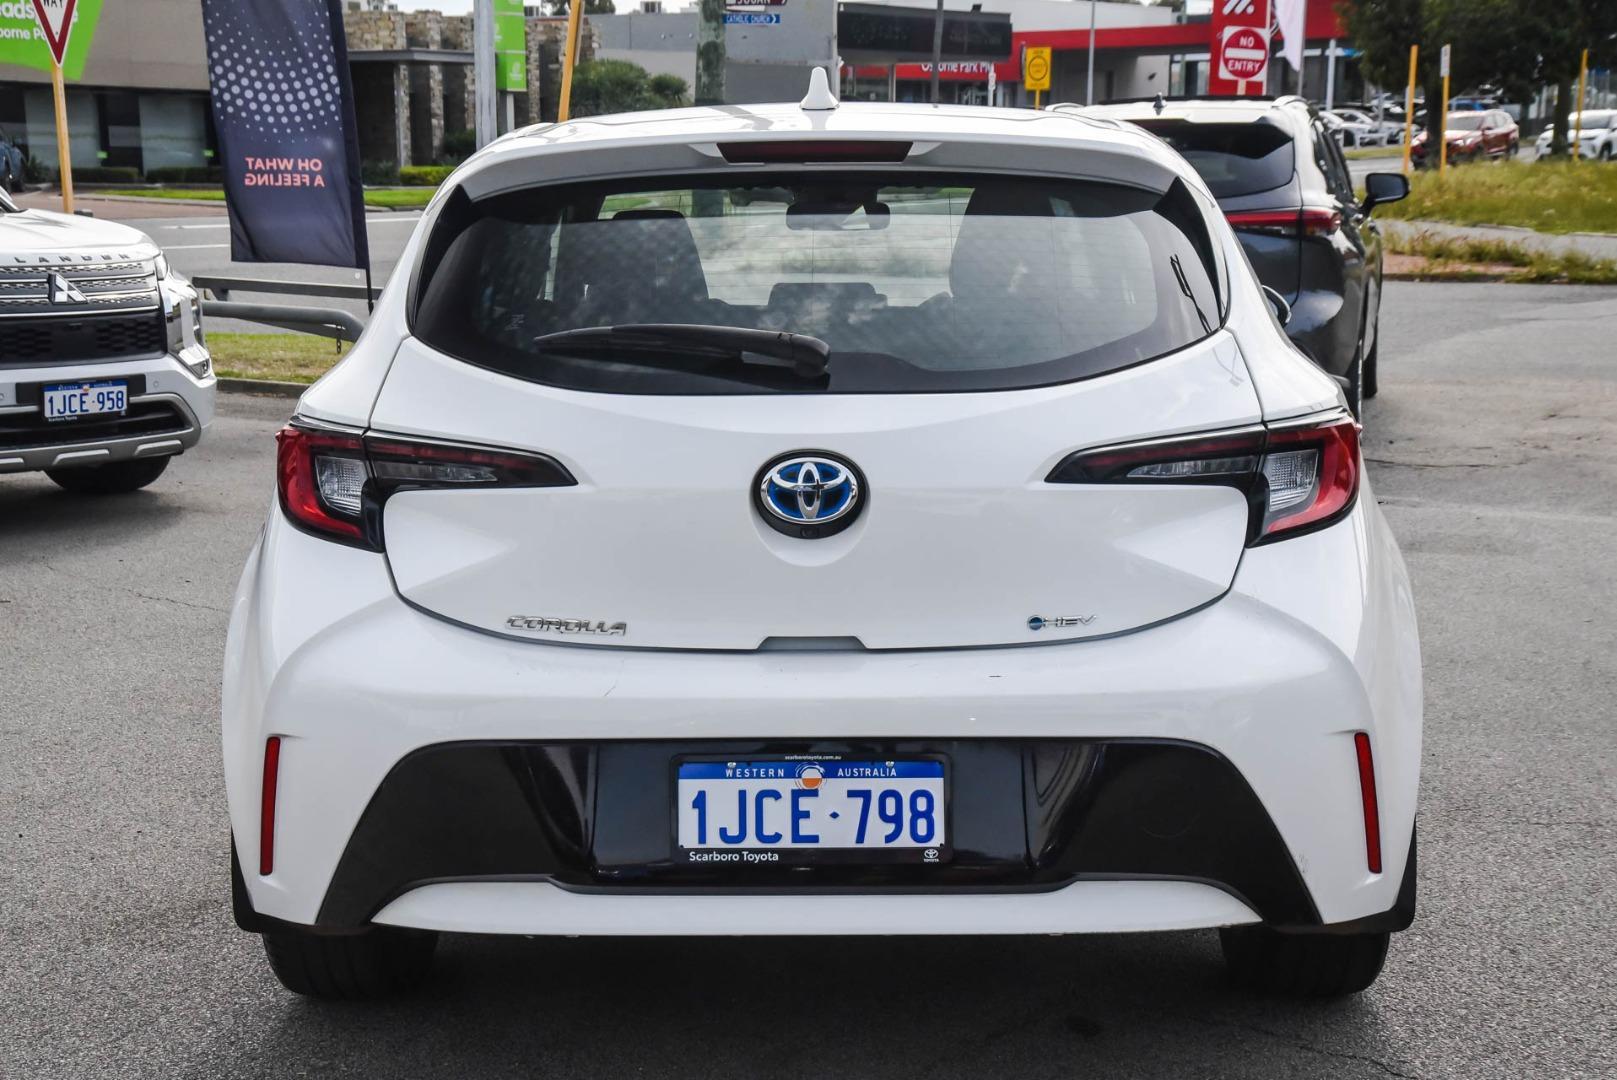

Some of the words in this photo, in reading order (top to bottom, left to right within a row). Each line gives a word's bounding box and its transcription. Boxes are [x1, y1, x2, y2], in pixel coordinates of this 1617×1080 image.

[1239, 36, 1254, 48] NO
[1228, 60, 1261, 72] ENTRY
[505, 615, 627, 636] COROLLA
[1042, 615, 1097, 628] HEV
[725, 768, 785, 778] WESTERN
[837, 767, 897, 777] AUSTRALIA
[689, 851, 739, 862] Scarboro
[742, 851, 779, 863] Toyota
